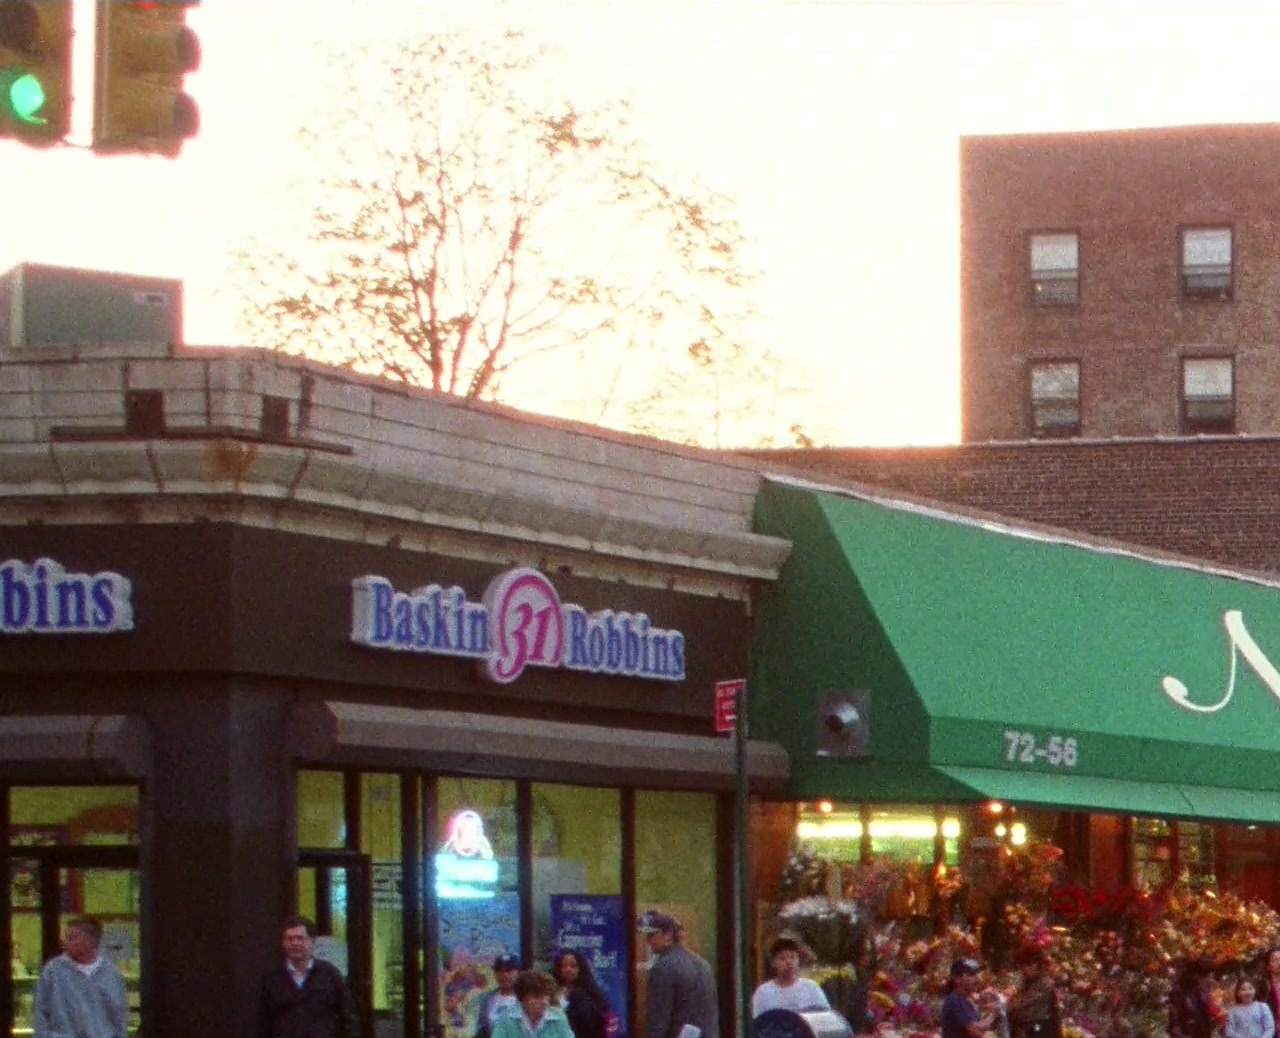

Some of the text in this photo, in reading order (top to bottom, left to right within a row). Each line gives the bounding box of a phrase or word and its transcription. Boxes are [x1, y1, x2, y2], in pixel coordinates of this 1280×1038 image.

[370, 580, 686, 679] Baskin 31 Robbins
[1004, 730, 1078, 767] 72-56
